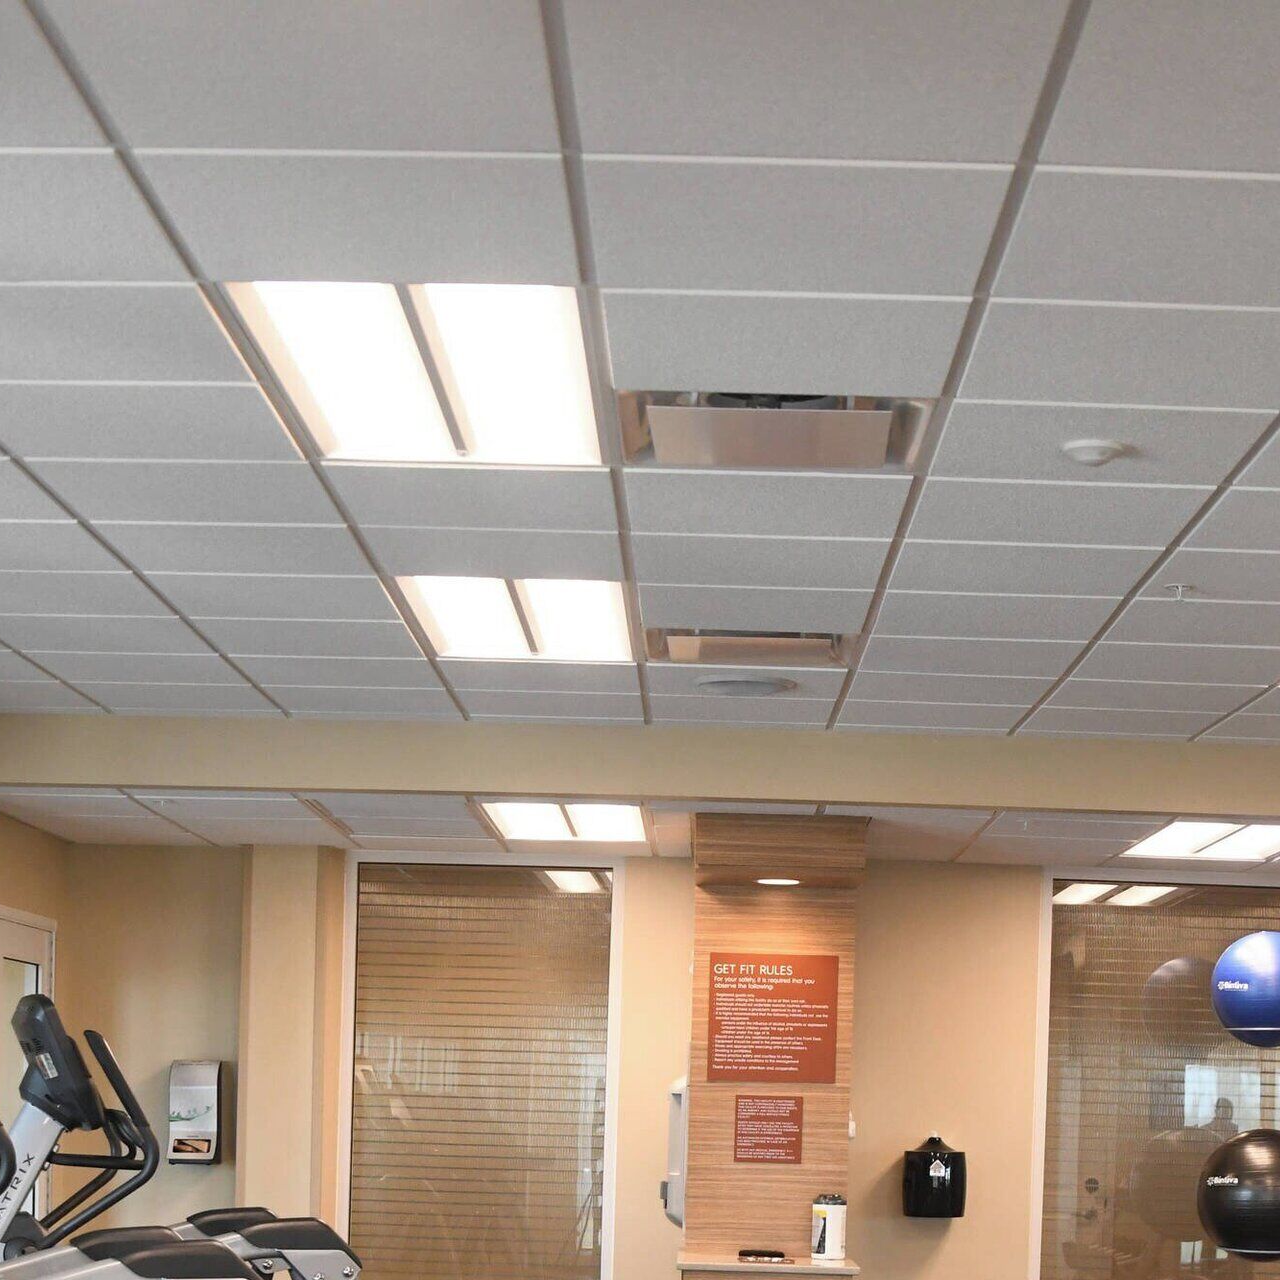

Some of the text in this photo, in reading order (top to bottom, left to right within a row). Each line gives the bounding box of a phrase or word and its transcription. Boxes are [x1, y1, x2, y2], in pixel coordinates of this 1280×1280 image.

[714, 964, 793, 976] GET FIT RULES
